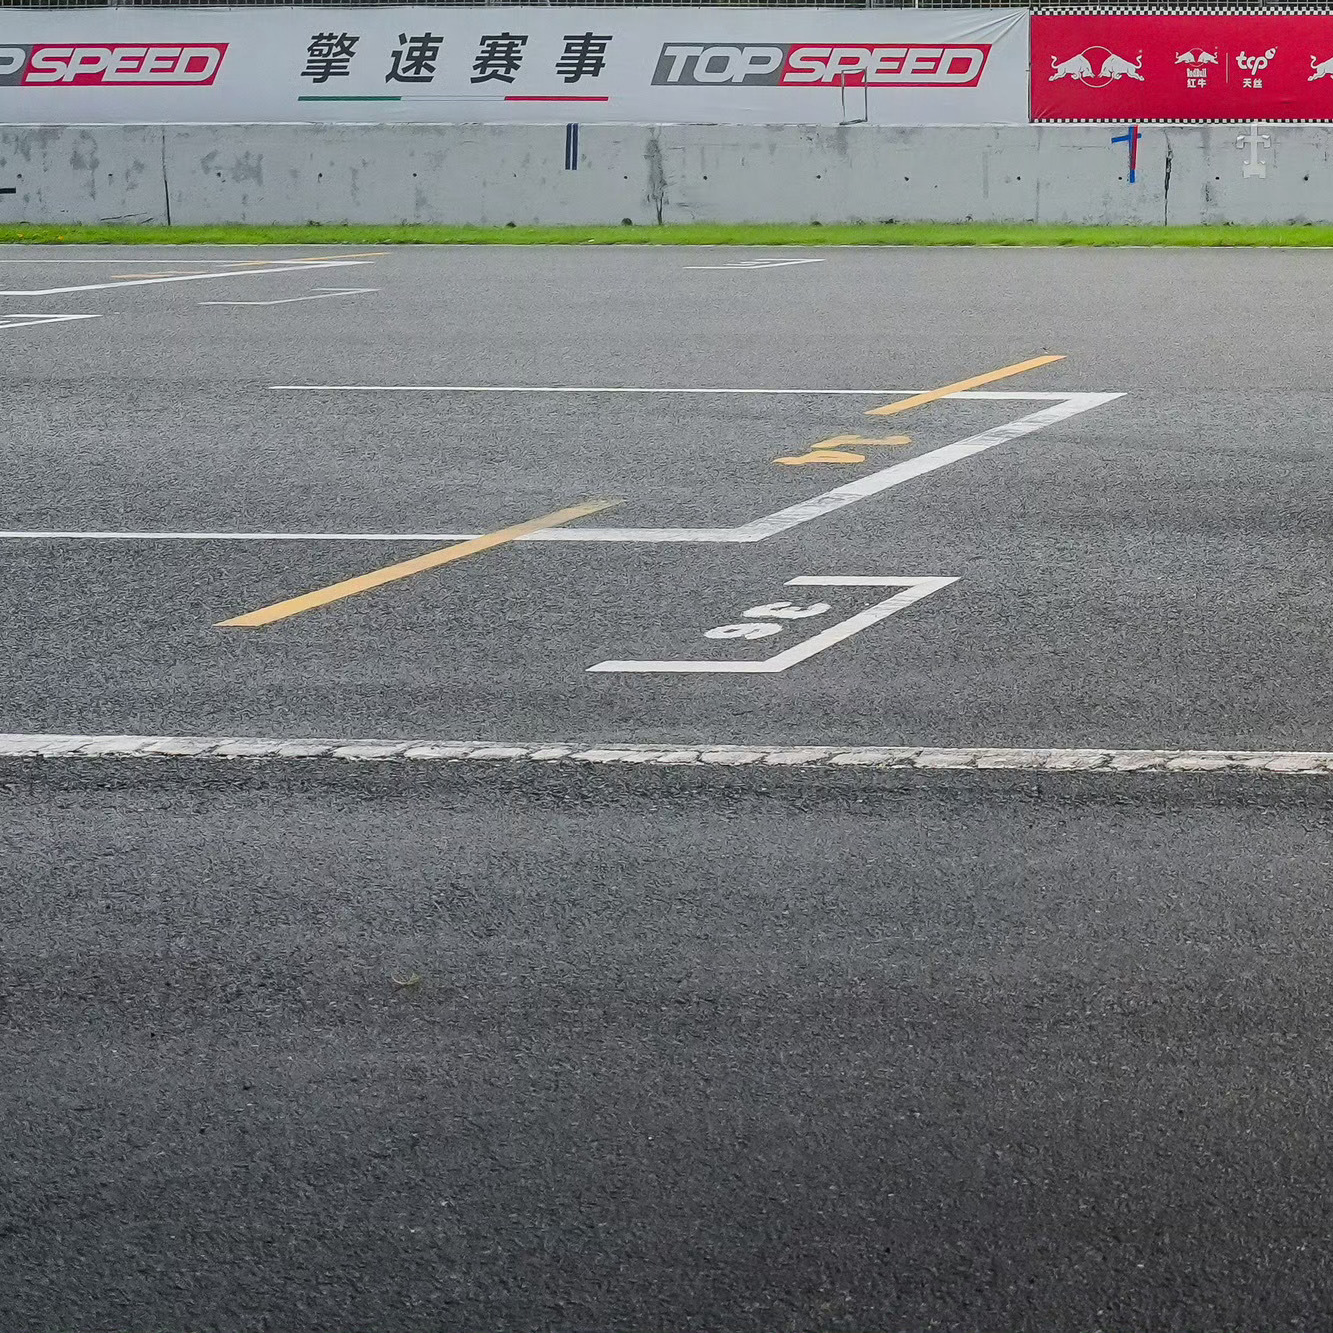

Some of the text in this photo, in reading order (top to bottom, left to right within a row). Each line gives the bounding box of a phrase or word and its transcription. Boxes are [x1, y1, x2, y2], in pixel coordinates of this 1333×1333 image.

[300, 32, 613, 84] 擎速赛事
[1235, 50, 1269, 76] tcp
[1187, 78, 1207, 88] 红牛
[1243, 78, 1263, 88] 天丝
[703, 600, 832, 640] 36
